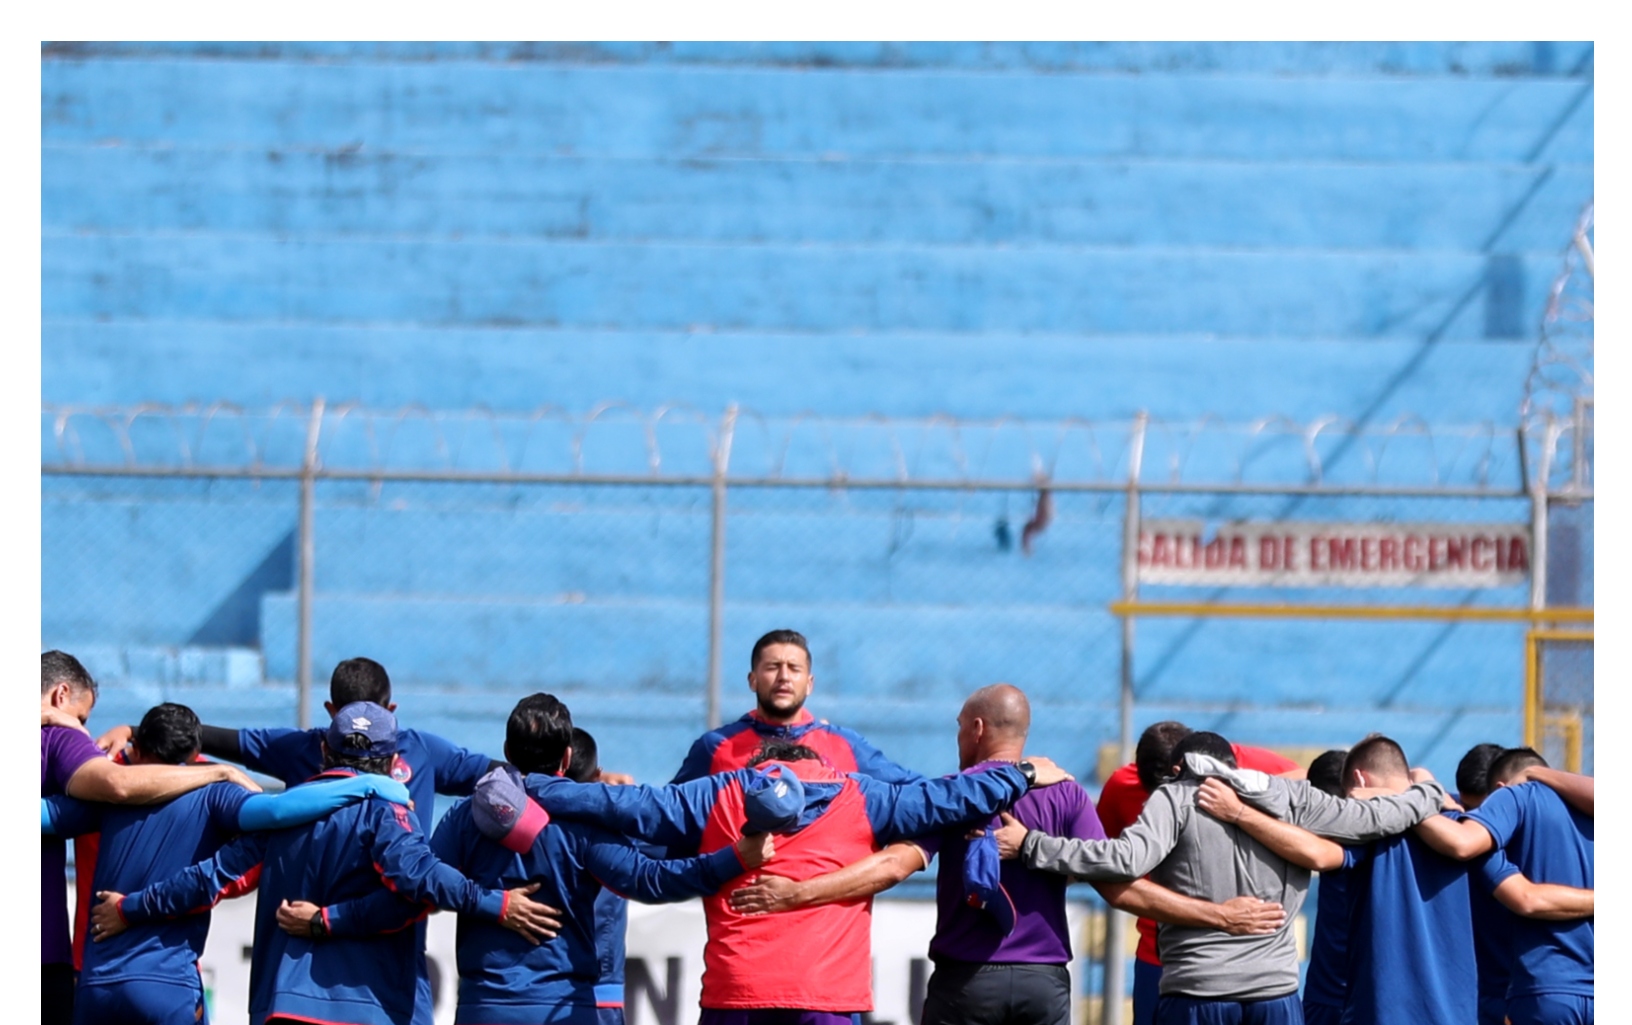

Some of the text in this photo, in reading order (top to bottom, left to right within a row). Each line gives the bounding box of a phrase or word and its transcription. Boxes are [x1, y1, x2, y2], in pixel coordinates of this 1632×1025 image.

[1139, 533, 1529, 572] SALIDA DE EMERGENCIA
